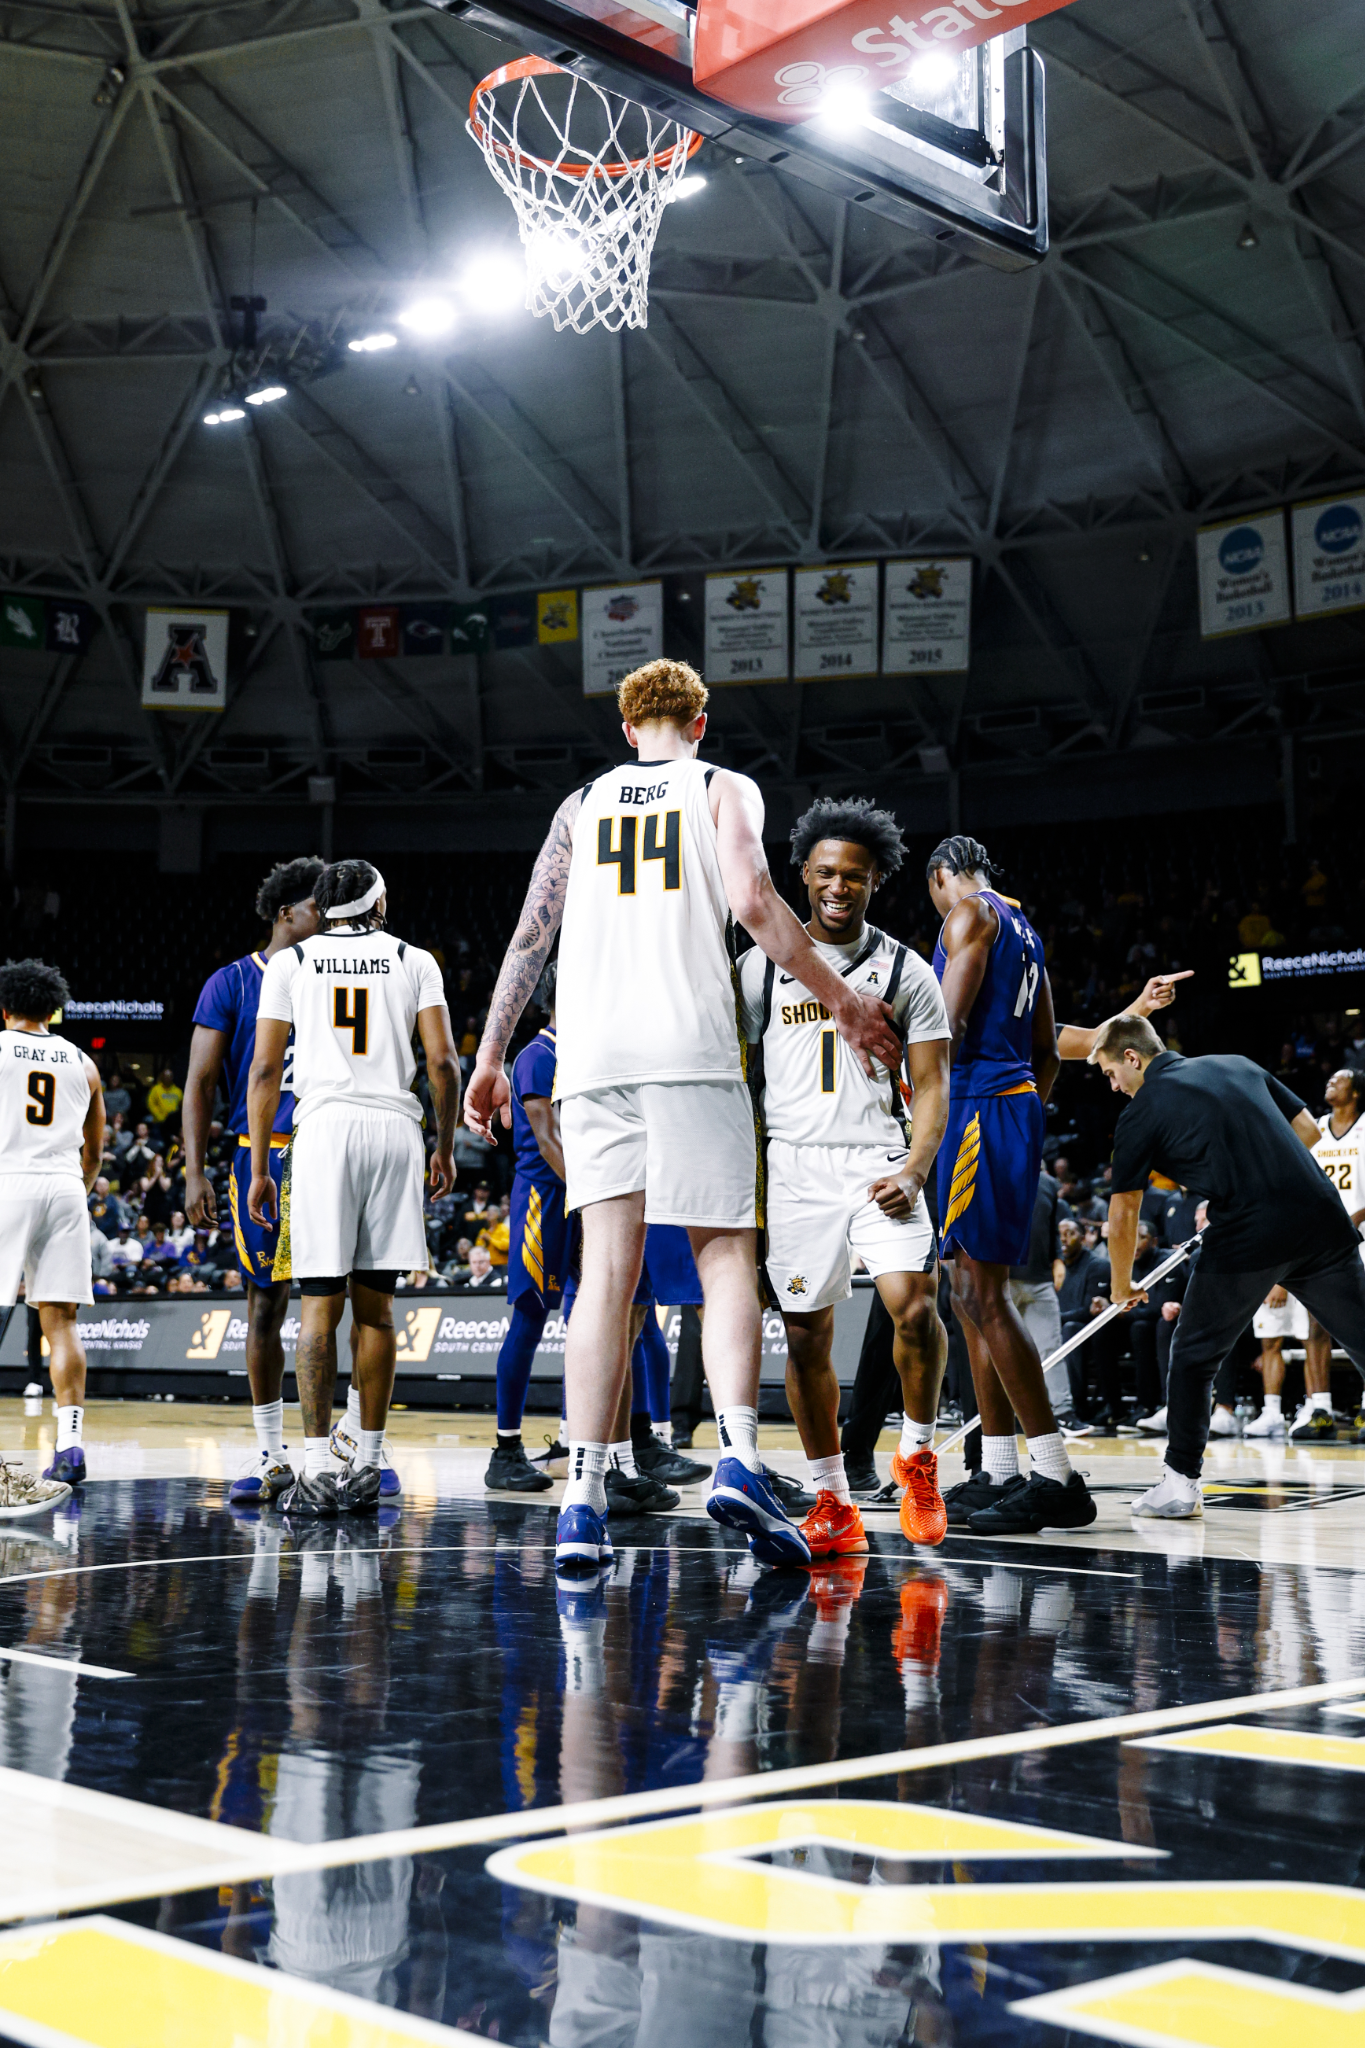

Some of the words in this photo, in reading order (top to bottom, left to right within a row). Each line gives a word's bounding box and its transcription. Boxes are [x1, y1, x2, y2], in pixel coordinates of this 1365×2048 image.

[819, 653, 853, 670] 2014
[908, 648, 942, 665] 2015
[730, 658, 763, 675] 2013
[619, 781, 669, 805] BERG
[596, 808, 682, 897] 44
[313, 958, 390, 974] WILLIAMS
[64, 1000, 164, 1014] ReeceNichols
[334, 986, 369, 1056] 4
[14, 1045, 45, 1062] GRAY
[51, 1051, 73, 1064] JR.
[820, 1029, 836, 1094] 1
[26, 1070, 56, 1127] 9
[434, 1342, 470, 1353] SOUTH
